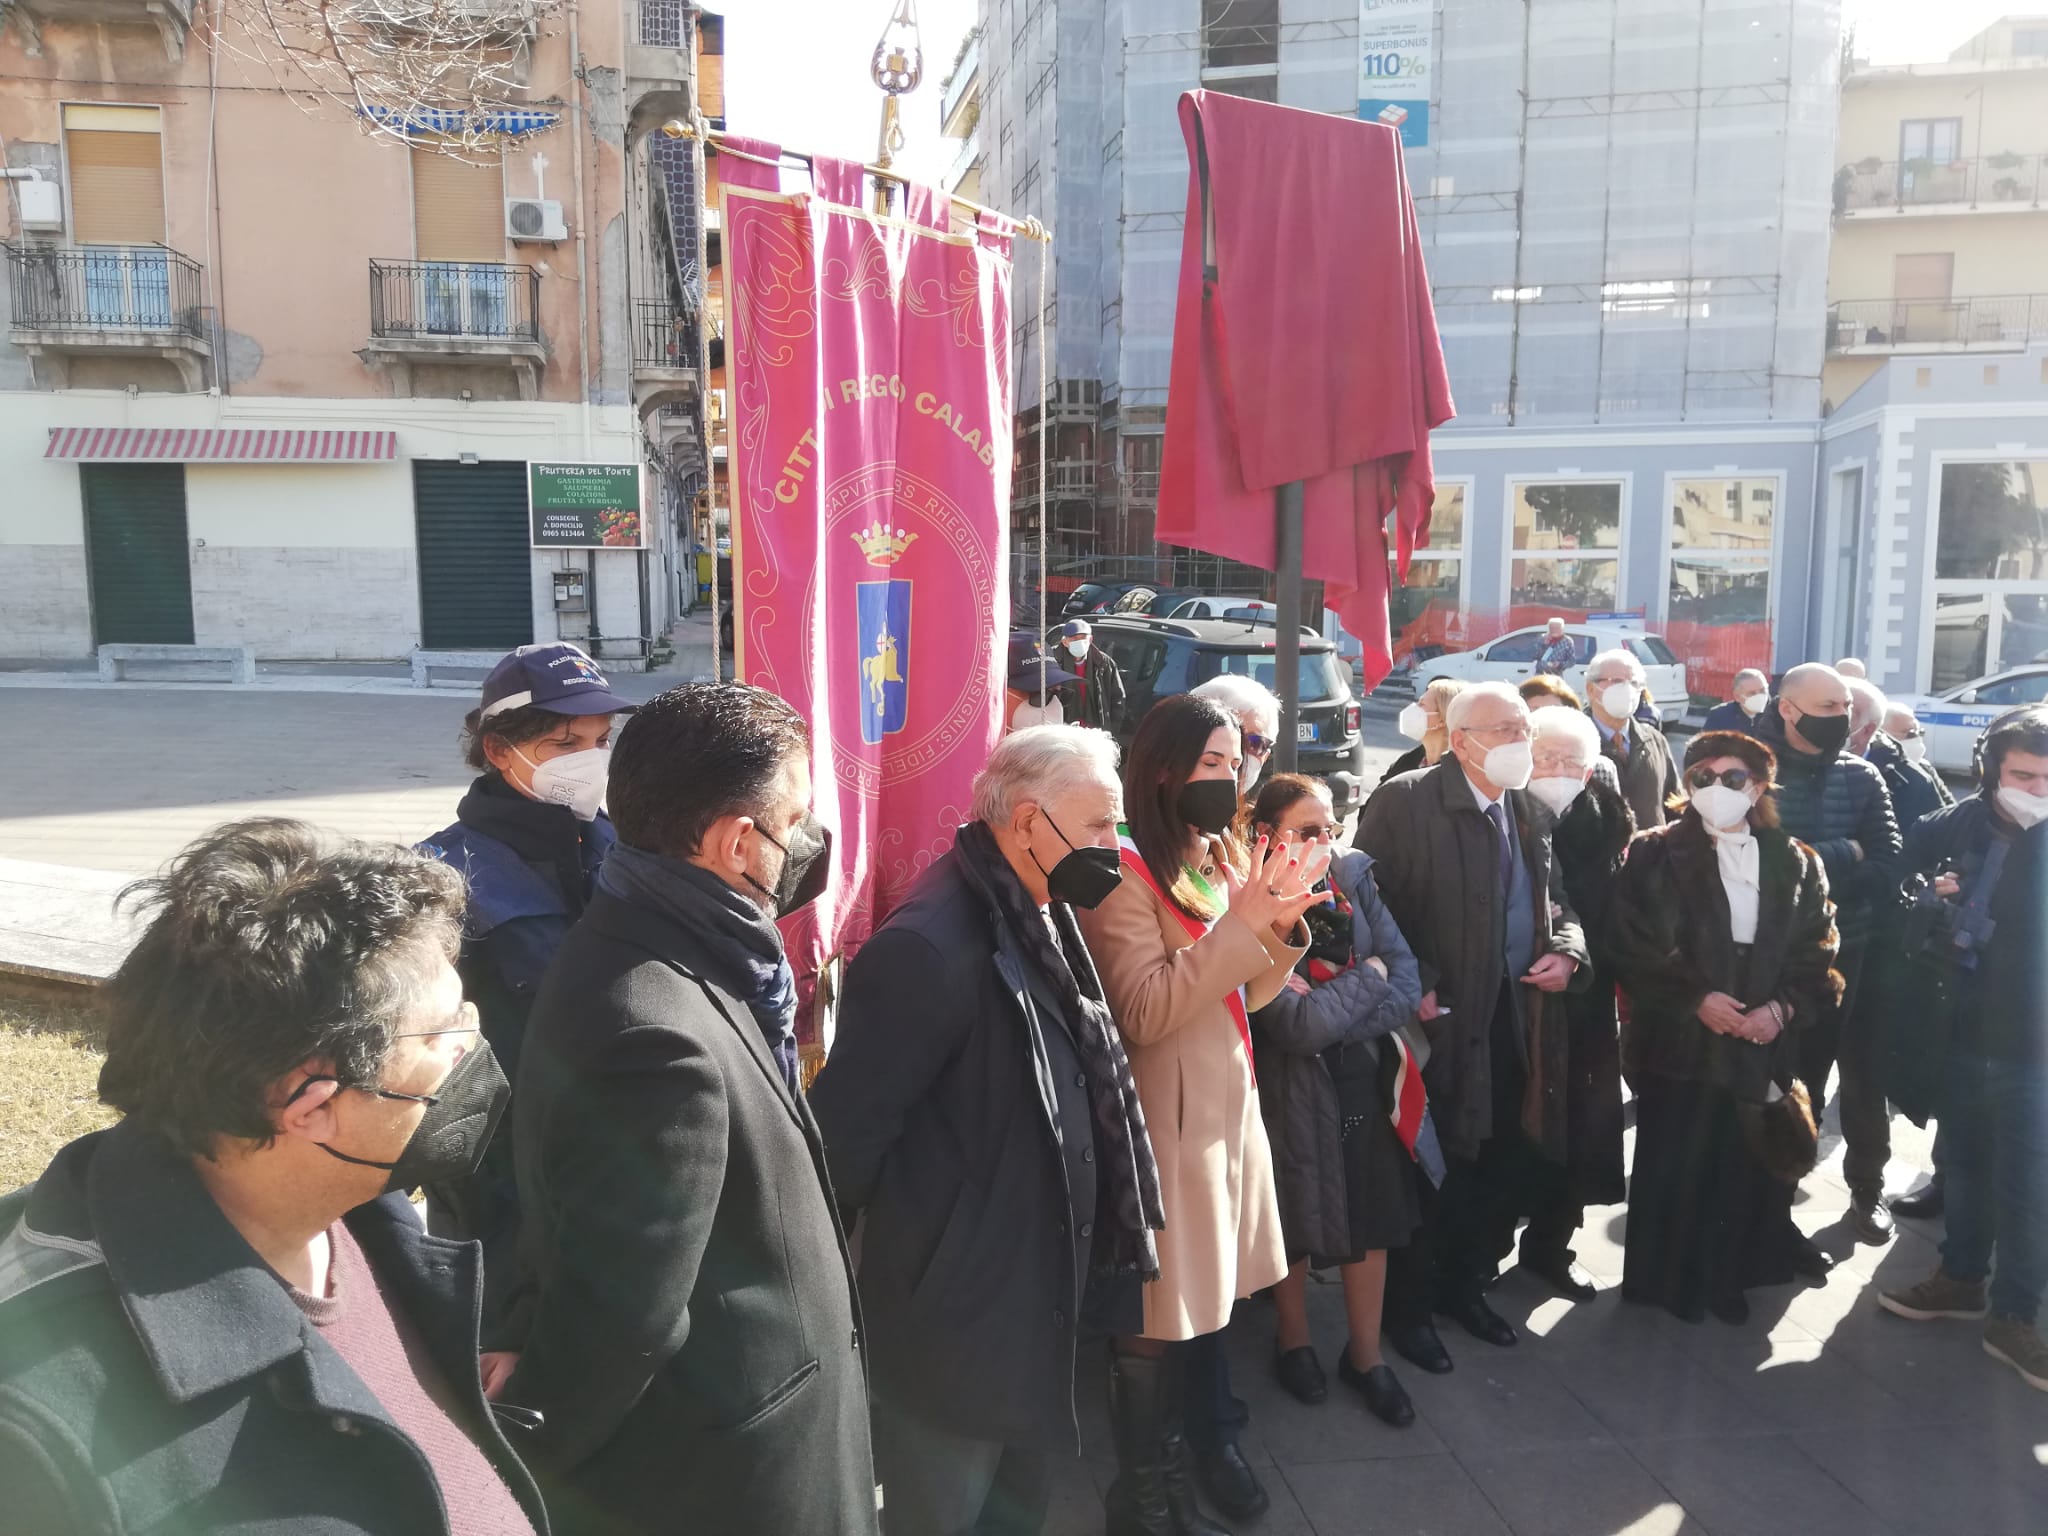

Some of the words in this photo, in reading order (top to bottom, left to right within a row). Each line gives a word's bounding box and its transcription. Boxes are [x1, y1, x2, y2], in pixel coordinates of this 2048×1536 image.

[1363, 37, 1428, 50] SUPERBONUS
[1363, 53, 1425, 76] 110%
[775, 427, 818, 503] CITT
[915, 392, 995, 475] CALAB
[539, 466, 585, 476] FRUTTERIA
[605, 467, 631, 476] PONTE
[1962, 714, 1992, 726] POLI
